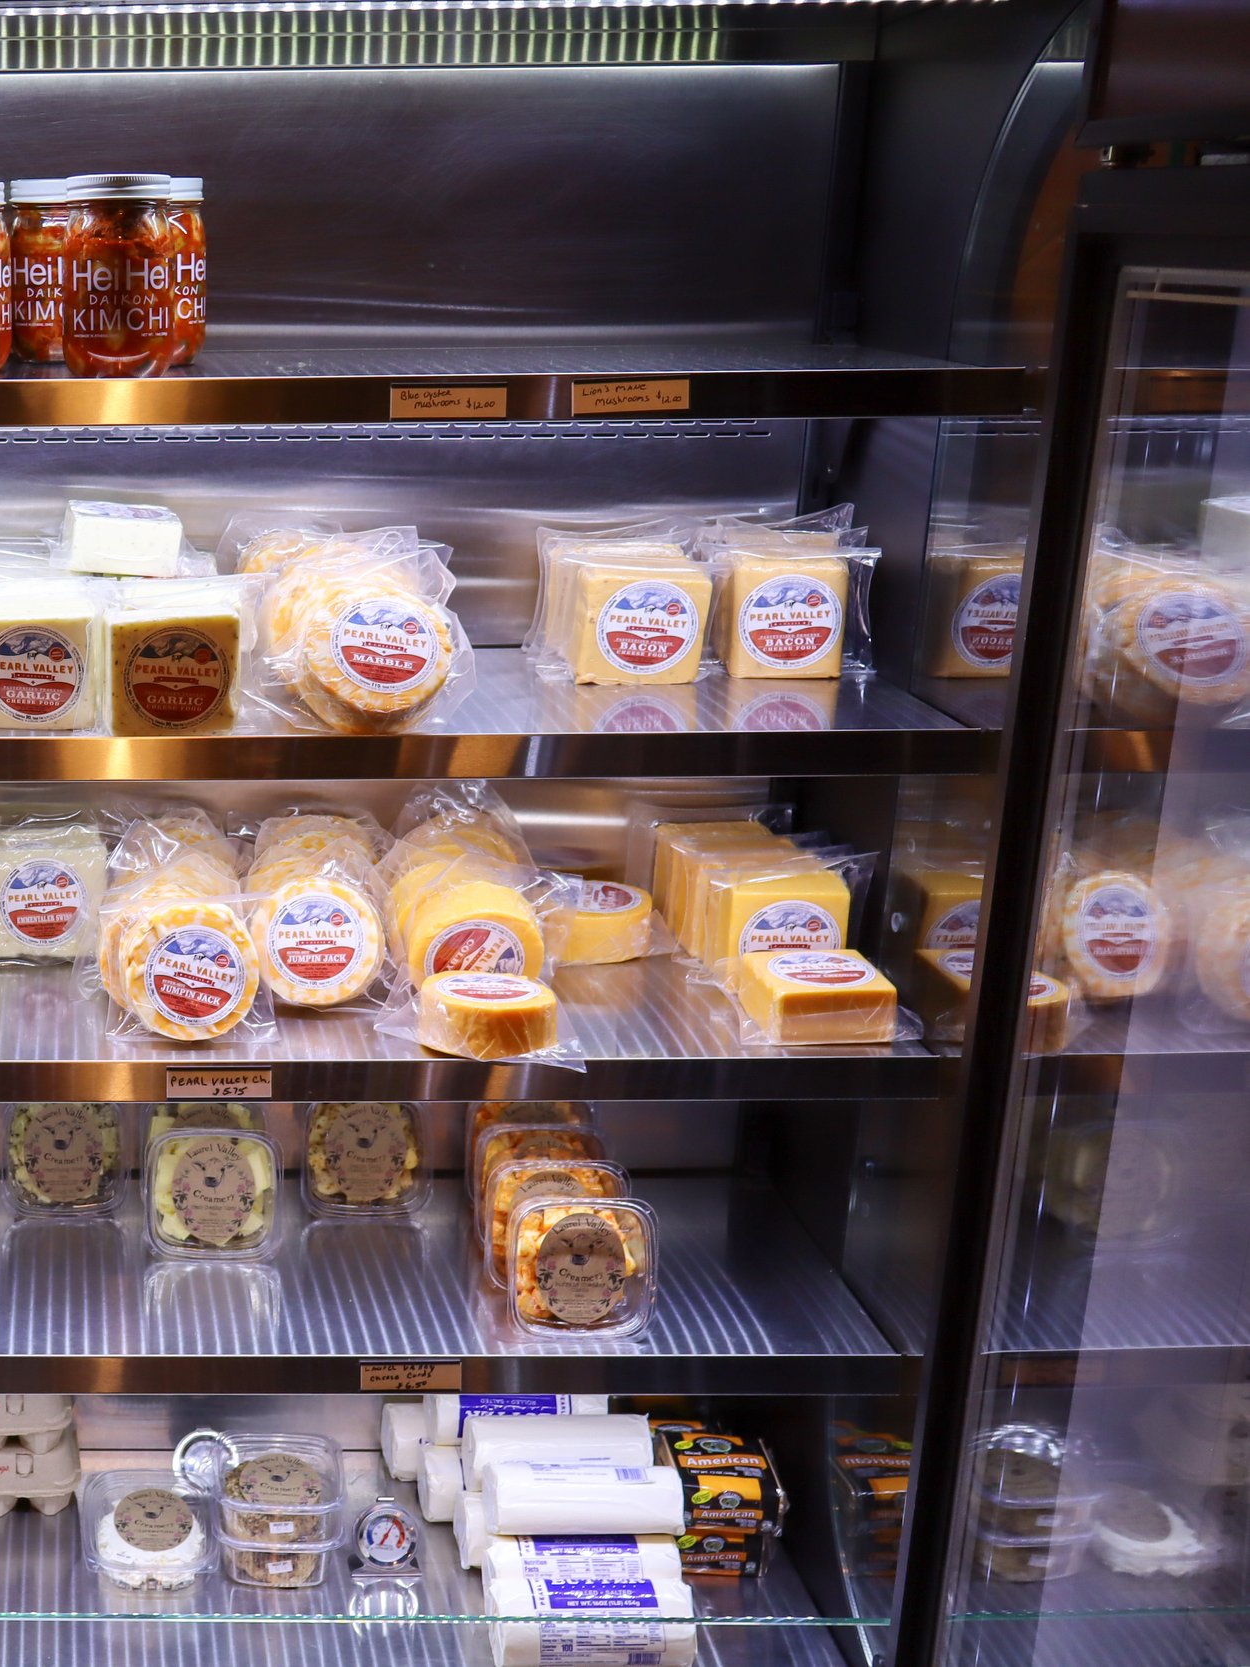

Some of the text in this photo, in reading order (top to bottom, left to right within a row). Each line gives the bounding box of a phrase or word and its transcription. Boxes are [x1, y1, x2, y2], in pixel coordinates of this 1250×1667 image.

[13, 256, 52, 287] Hei
[72, 258, 169, 291] Hei Hei
[90, 293, 155, 305] DAIKON
[73, 307, 169, 331] KIMCHI
[400, 390, 419, 401] Blue
[609, 615, 687, 628] PEARL VALLEY
[750, 610, 831, 621] PEARL VALLEY
[343, 628, 427, 648] PEARL VALLEY
[765, 636, 815, 646] BACON
[619, 641, 667, 652] BACON
[352, 653, 414, 669] MARBLE
[33, 663, 74, 674] VALLEY
[134, 664, 219, 677] PEARL VALLEY
[5, 691, 61, 701] GARLIC
[147, 694, 203, 705] GARLIC
[8, 891, 78, 902] PEARL VALLEY
[278, 930, 354, 939] PEARL VALLEY
[751, 934, 829, 943] PEARL VALLEY
[286, 953, 347, 963] JUMPIN JACK
[158, 956, 236, 984] PEARL VALLEY
[160, 984, 222, 1007] JUMPIN JACK
[170, 1075, 207, 1087] PEARL
[186, 1143, 241, 1161] Laurel Valley
[347, 1150, 387, 1162] Creamery
[44, 1153, 84, 1165] Creamery
[520, 1176, 577, 1194] Laurel Valley
[193, 1190, 235, 1203] Creamery
[552, 1218, 611, 1236] Laurel Valley
[559, 1268, 604, 1282] Creamery
[687, 1455, 760, 1466] American
[701, 1510, 755, 1518] American
[686, 1553, 739, 1561] American
[561, 1644, 574, 1652] 100
